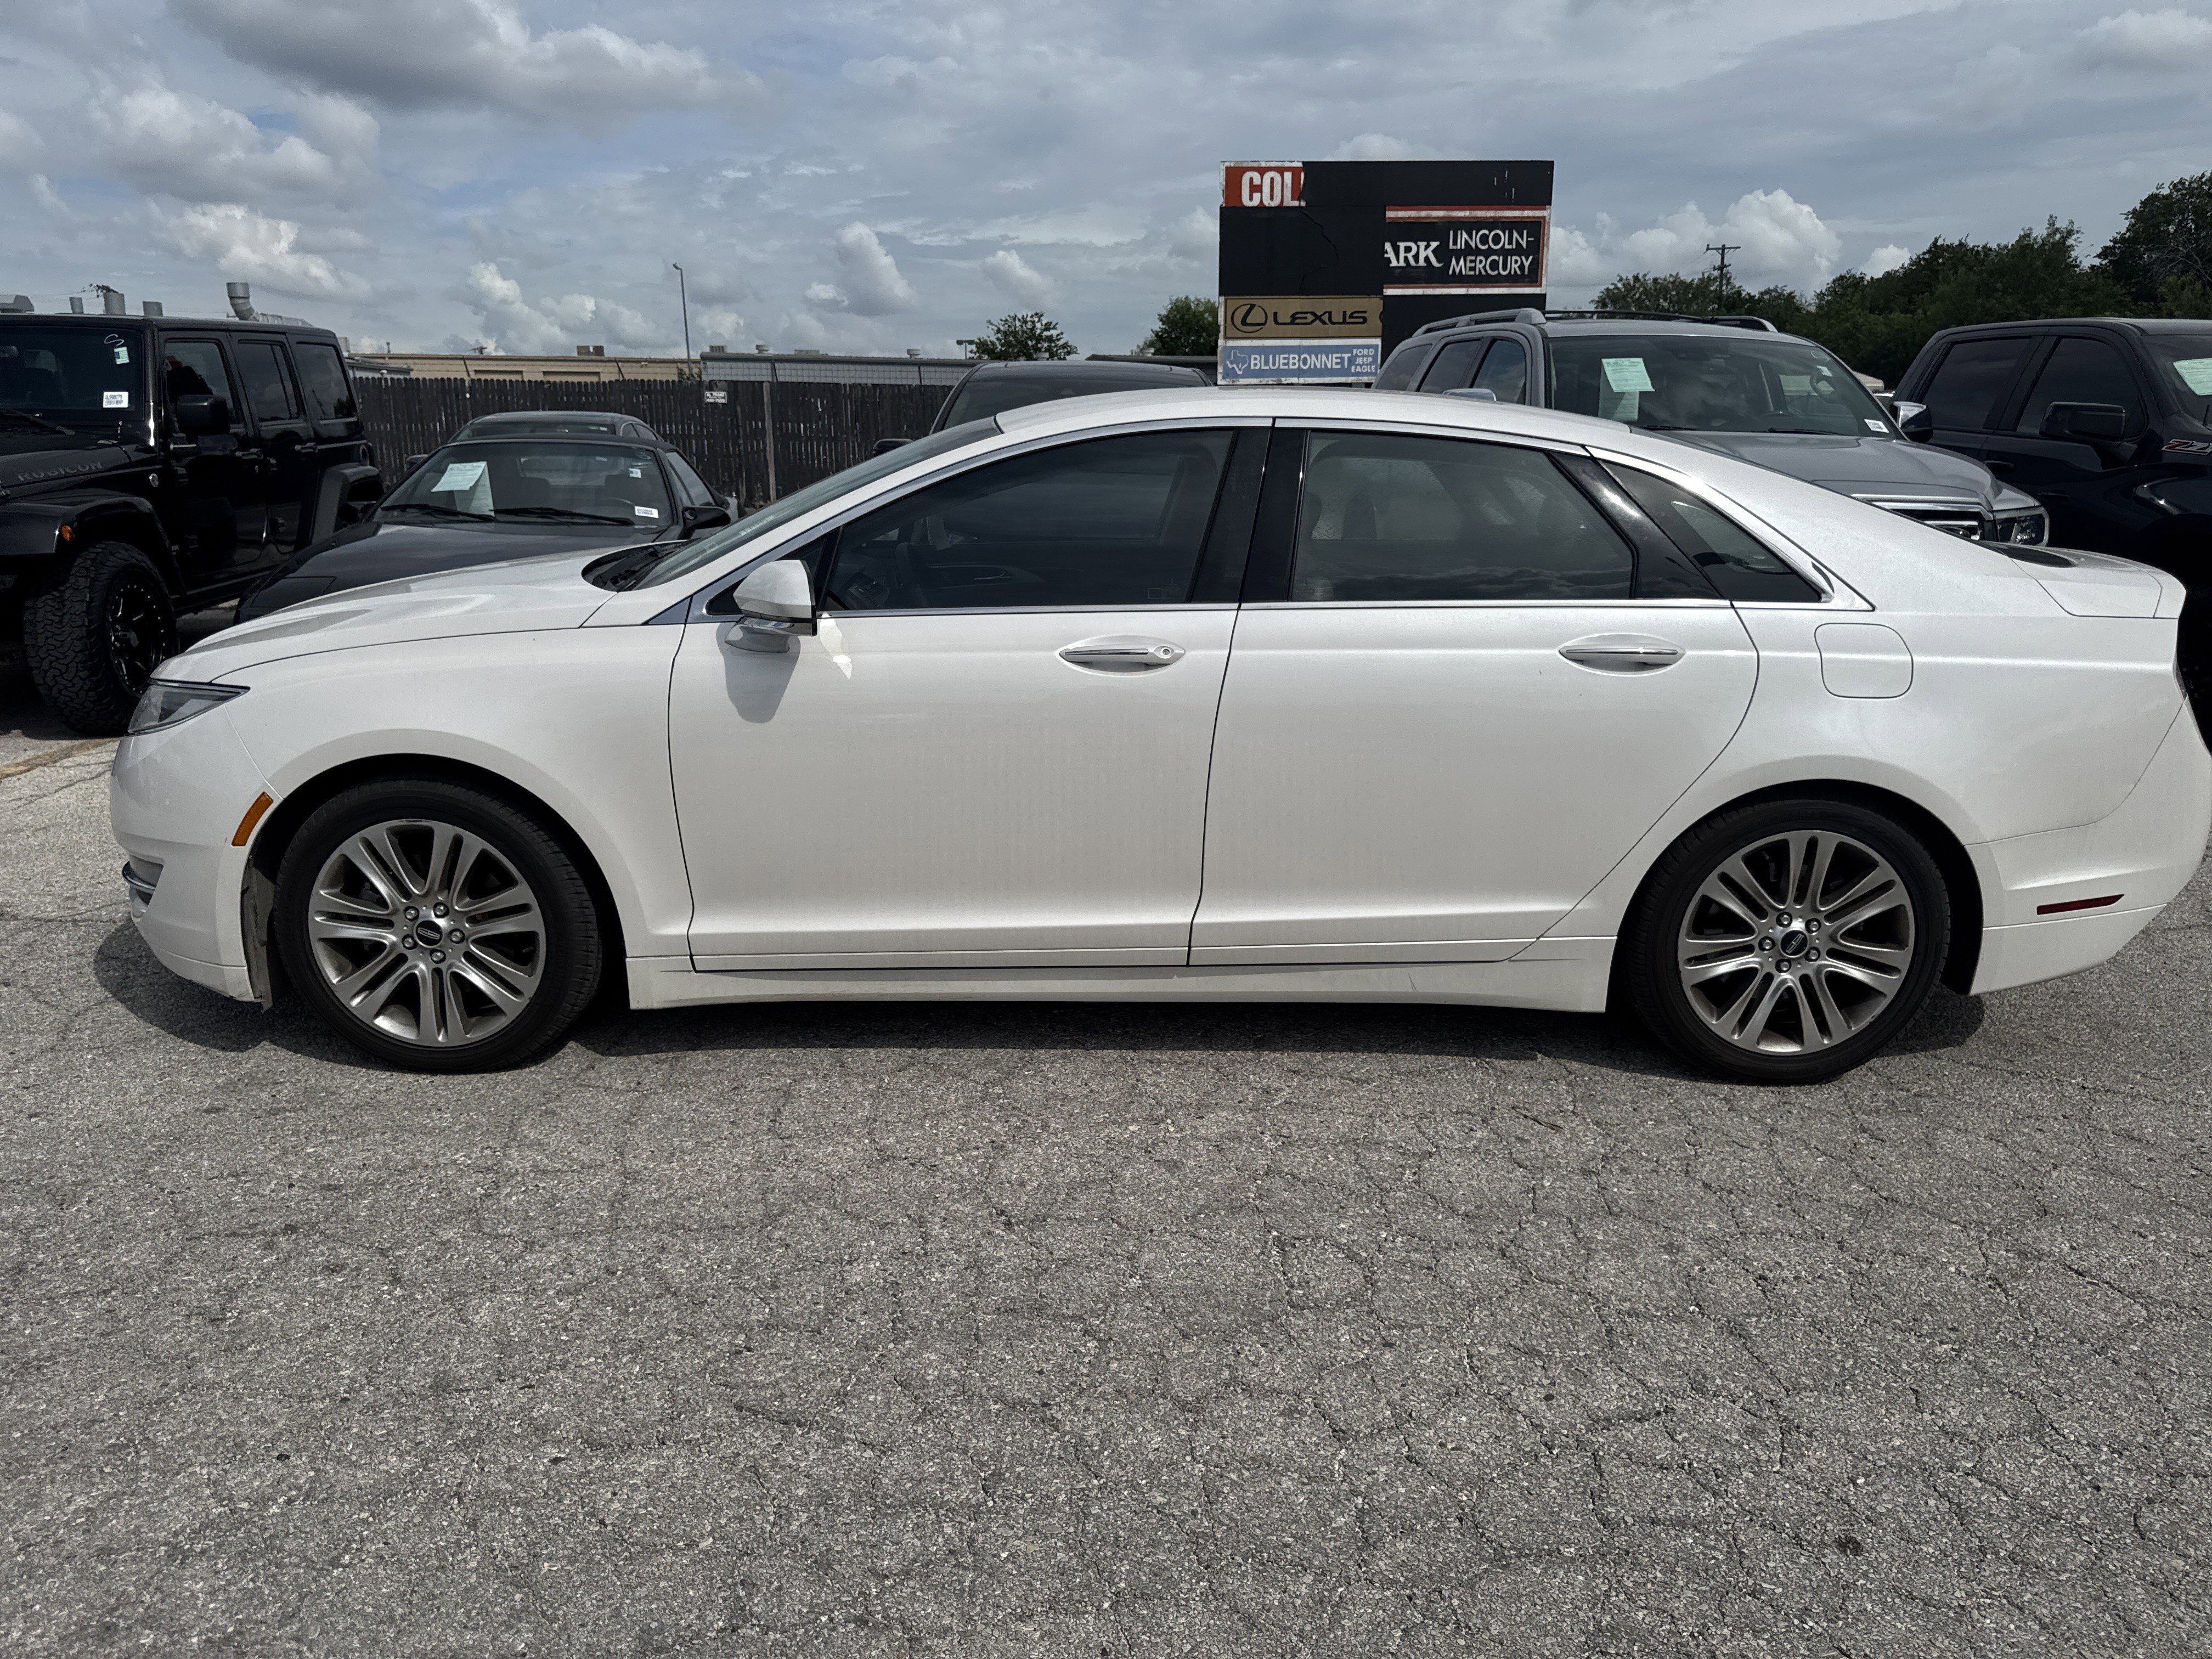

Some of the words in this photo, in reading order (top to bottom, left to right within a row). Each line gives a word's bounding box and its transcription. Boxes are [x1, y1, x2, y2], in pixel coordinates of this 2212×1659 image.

[1242, 171, 1306, 207] COL
[1449, 229, 1534, 250] LINCOLN-
[1448, 256, 1533, 275] MERCURY
[1273, 311, 1368, 325] LEXUS
[1250, 353, 1351, 370] BLUEBONNET
[2161, 439, 2212, 455] Z7
[17, 461, 103, 482] RUBICON
